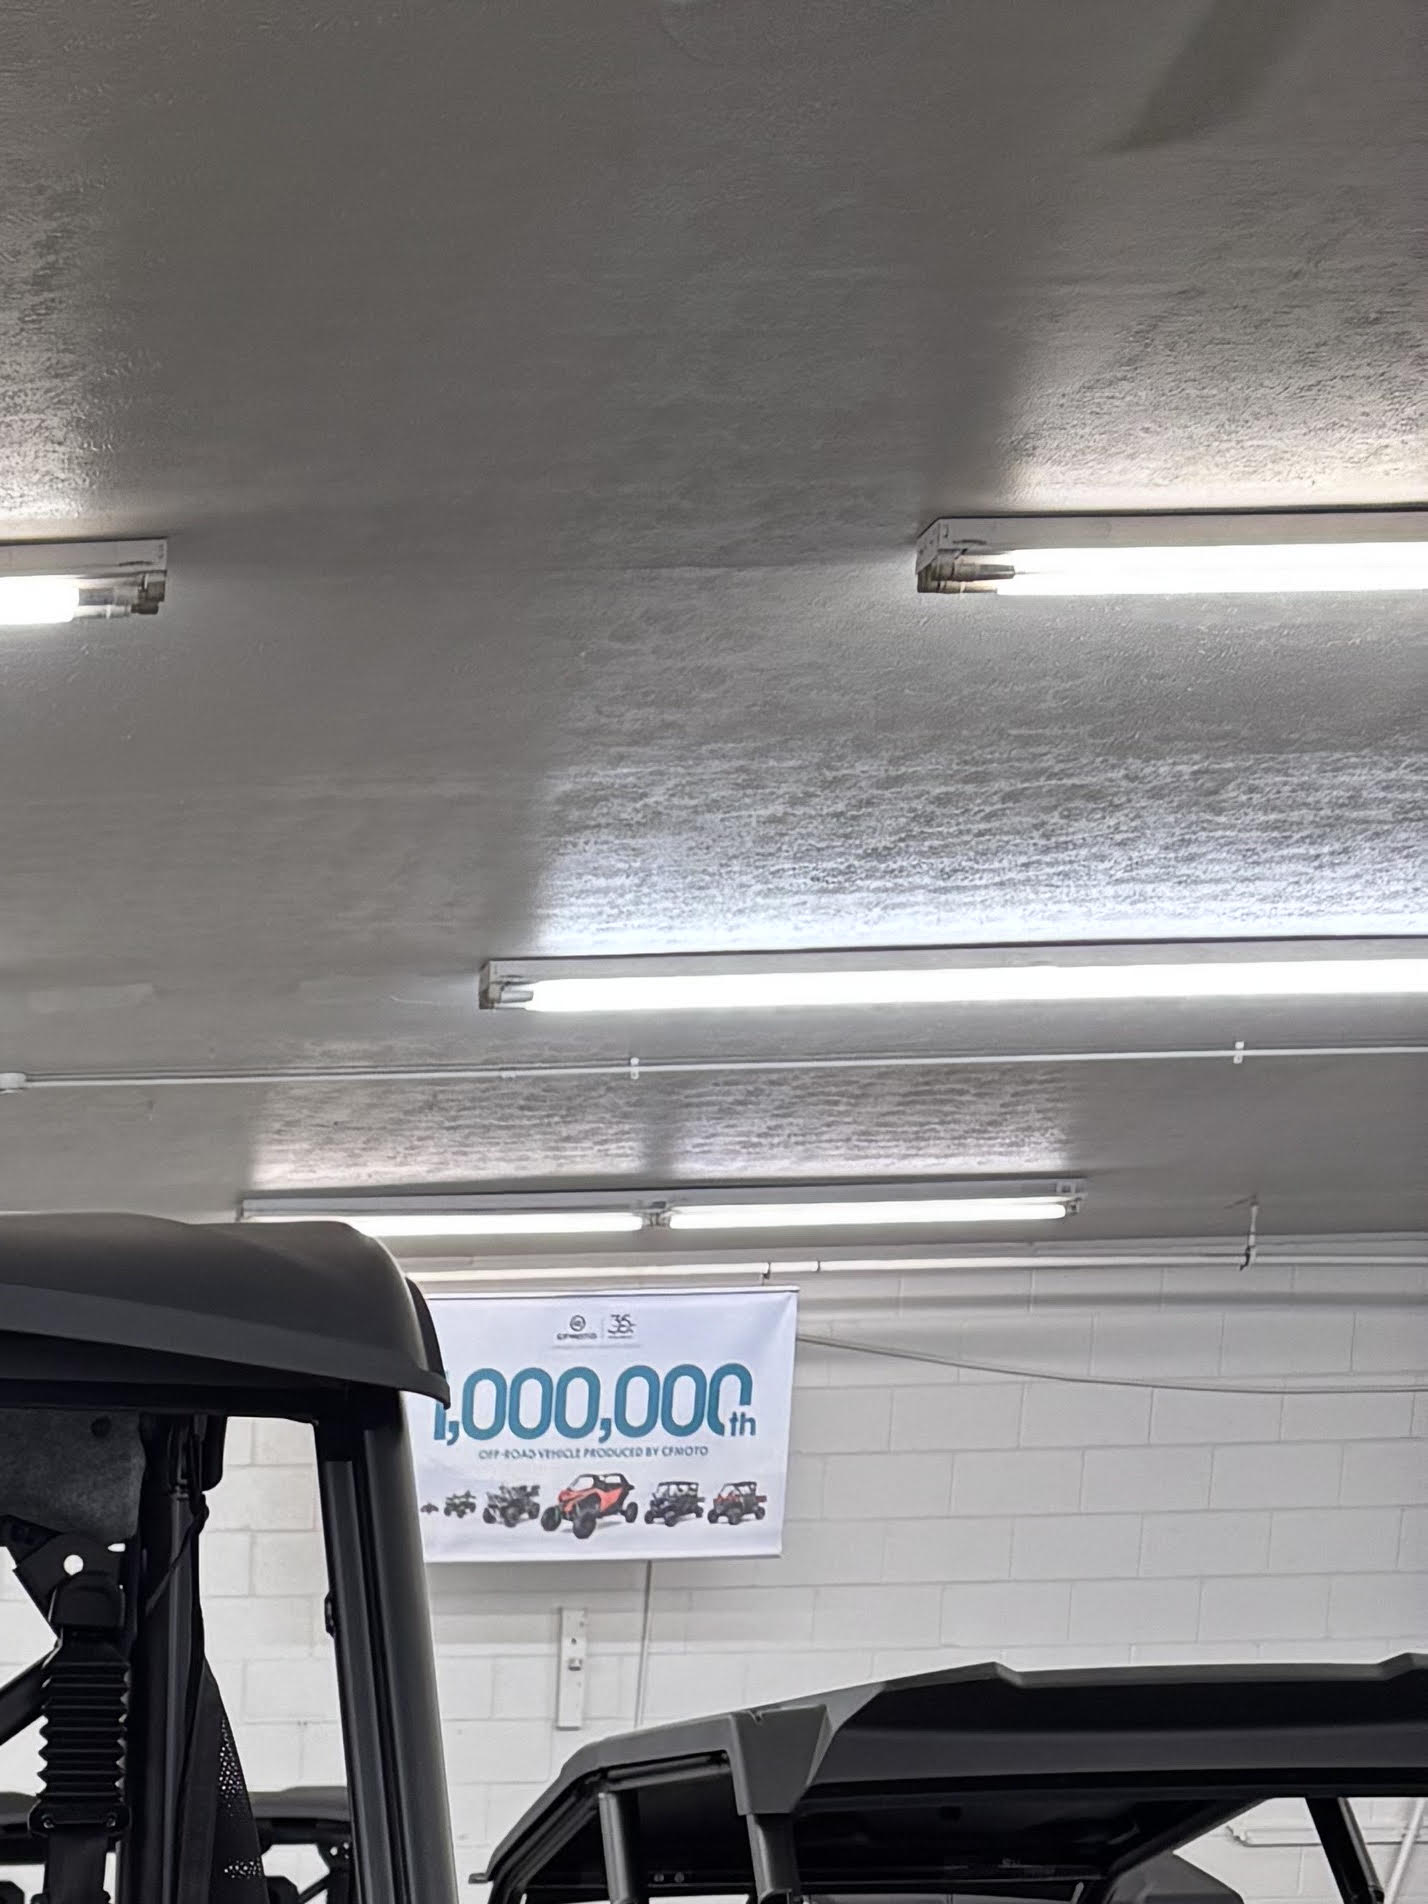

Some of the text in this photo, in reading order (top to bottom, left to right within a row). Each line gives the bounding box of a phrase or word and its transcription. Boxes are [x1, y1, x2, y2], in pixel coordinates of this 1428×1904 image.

[538, 1449, 581, 1459] VEHICLE
[583, 1447, 643, 1458] PRODUCED
[645, 1447, 659, 1457] BY
